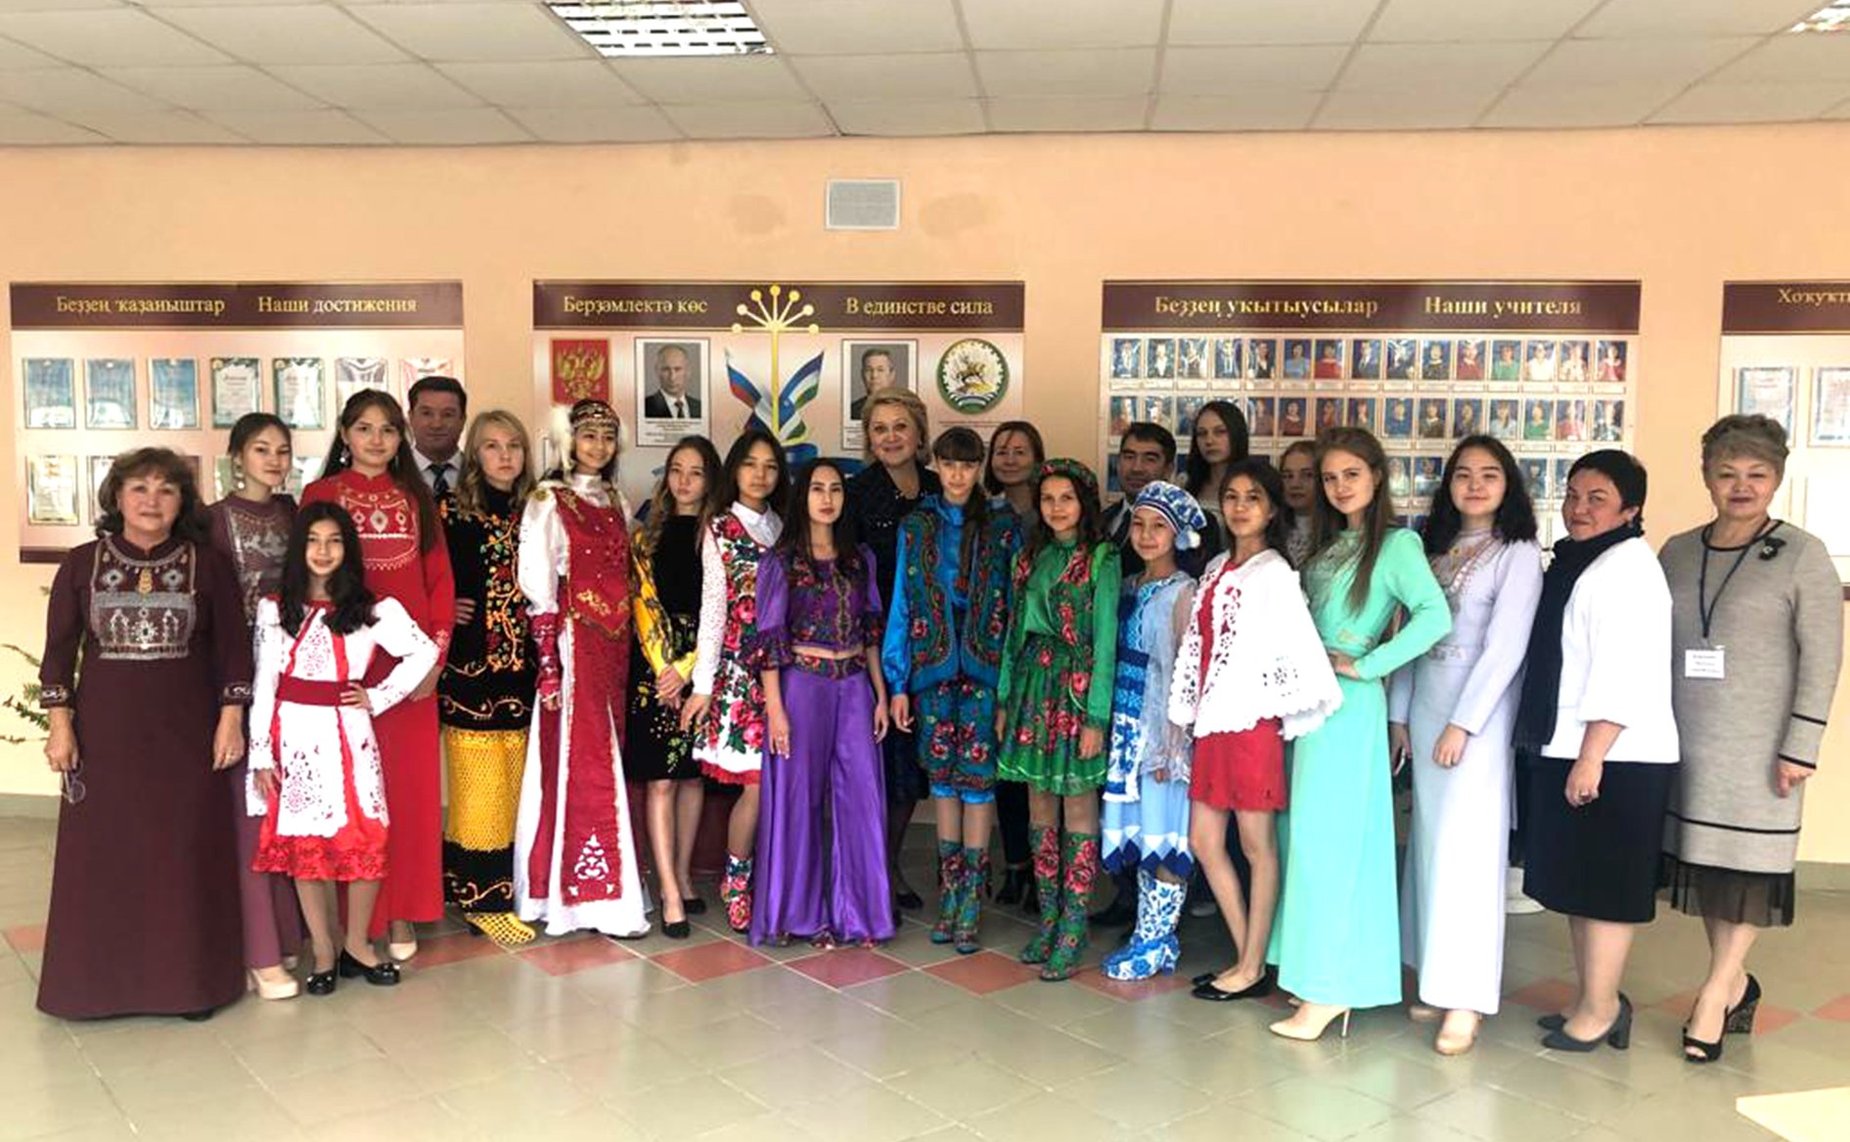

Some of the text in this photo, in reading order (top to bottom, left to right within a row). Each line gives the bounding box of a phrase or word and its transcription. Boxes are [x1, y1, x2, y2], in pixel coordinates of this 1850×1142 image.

[258, 296, 417, 315] Наши достижения
[678, 300, 708, 314] көс
[846, 297, 993, 316] В единстве сила
[1425, 296, 1582, 319] Наши учителя
